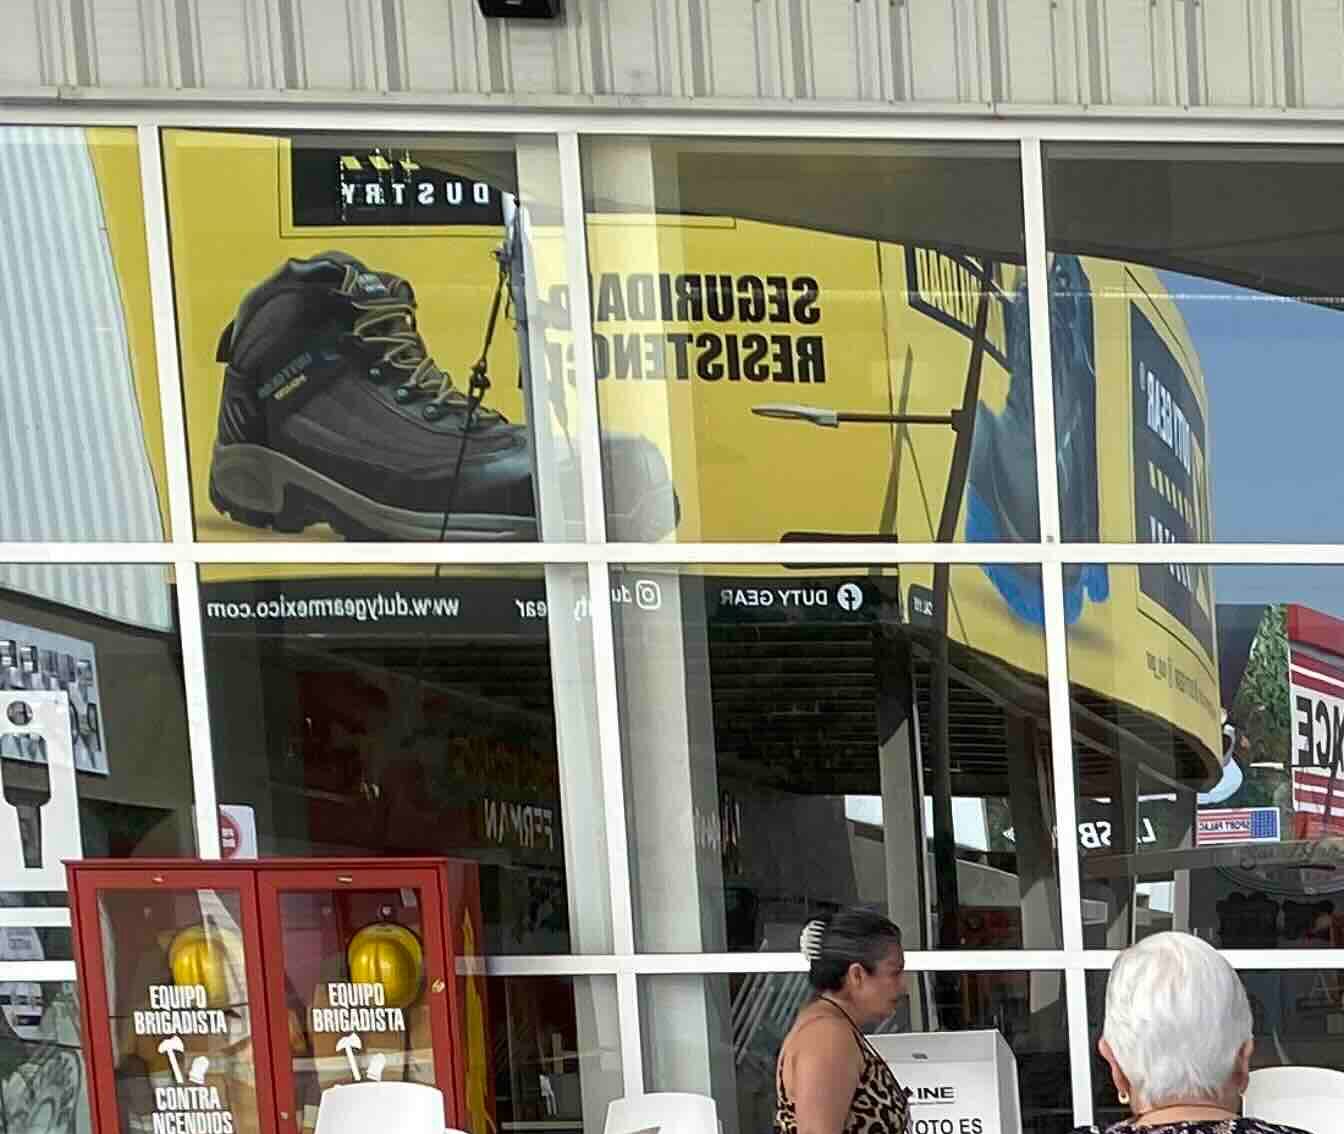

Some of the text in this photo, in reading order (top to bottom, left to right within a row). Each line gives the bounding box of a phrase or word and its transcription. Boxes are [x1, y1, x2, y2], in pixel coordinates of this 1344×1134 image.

[149, 984, 207, 1010] EQUIPO
[328, 982, 386, 1008] EQUIPO
[134, 1010, 228, 1036] BRIGADISTA
[313, 1008, 405, 1033] BRIGADISTA
[155, 1086, 221, 1111] CONTRA
[917, 1086, 955, 1099] INE
[960, 1118, 983, 1134] ES
